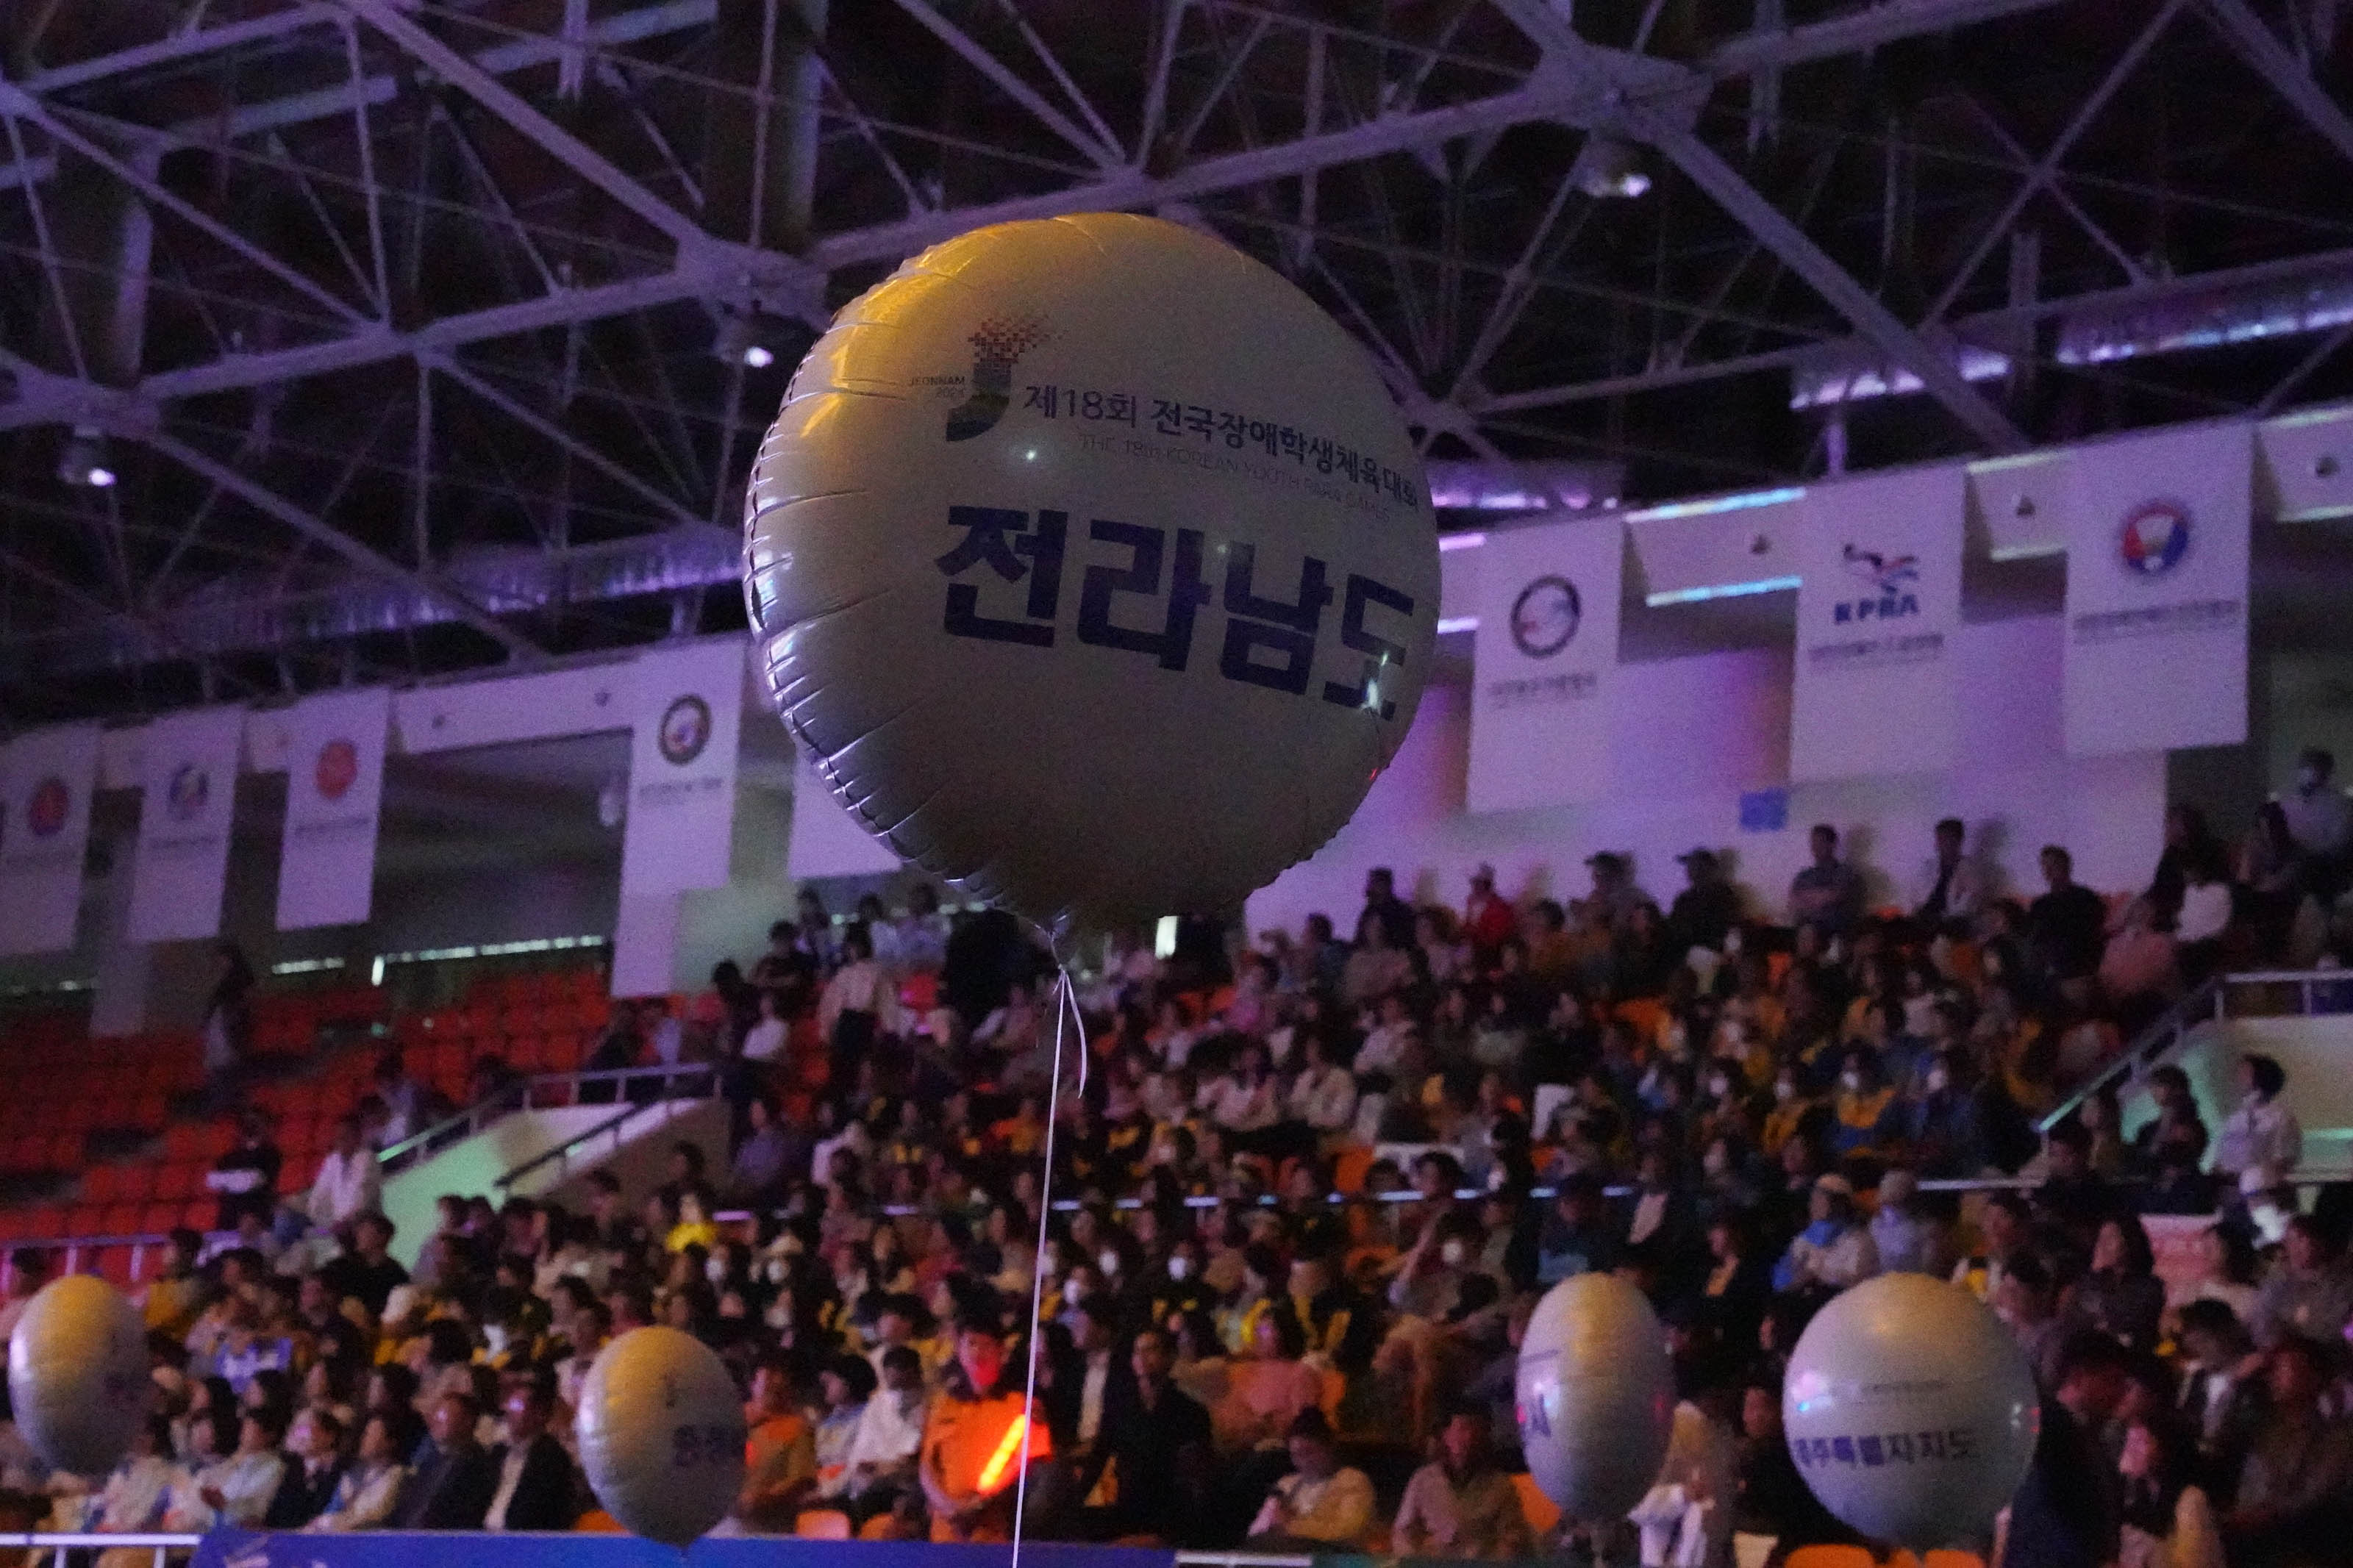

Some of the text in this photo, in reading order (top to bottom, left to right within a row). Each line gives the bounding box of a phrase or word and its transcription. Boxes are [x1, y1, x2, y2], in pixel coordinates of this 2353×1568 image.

[908, 375, 965, 388] JEONNAM
[1023, 384, 1418, 507] 제18회 전국장애학생체육대회
[1079, 432, 1116, 454] THE
[1166, 446, 1239, 473] KOREAN
[934, 505, 1415, 723] 전라남도
